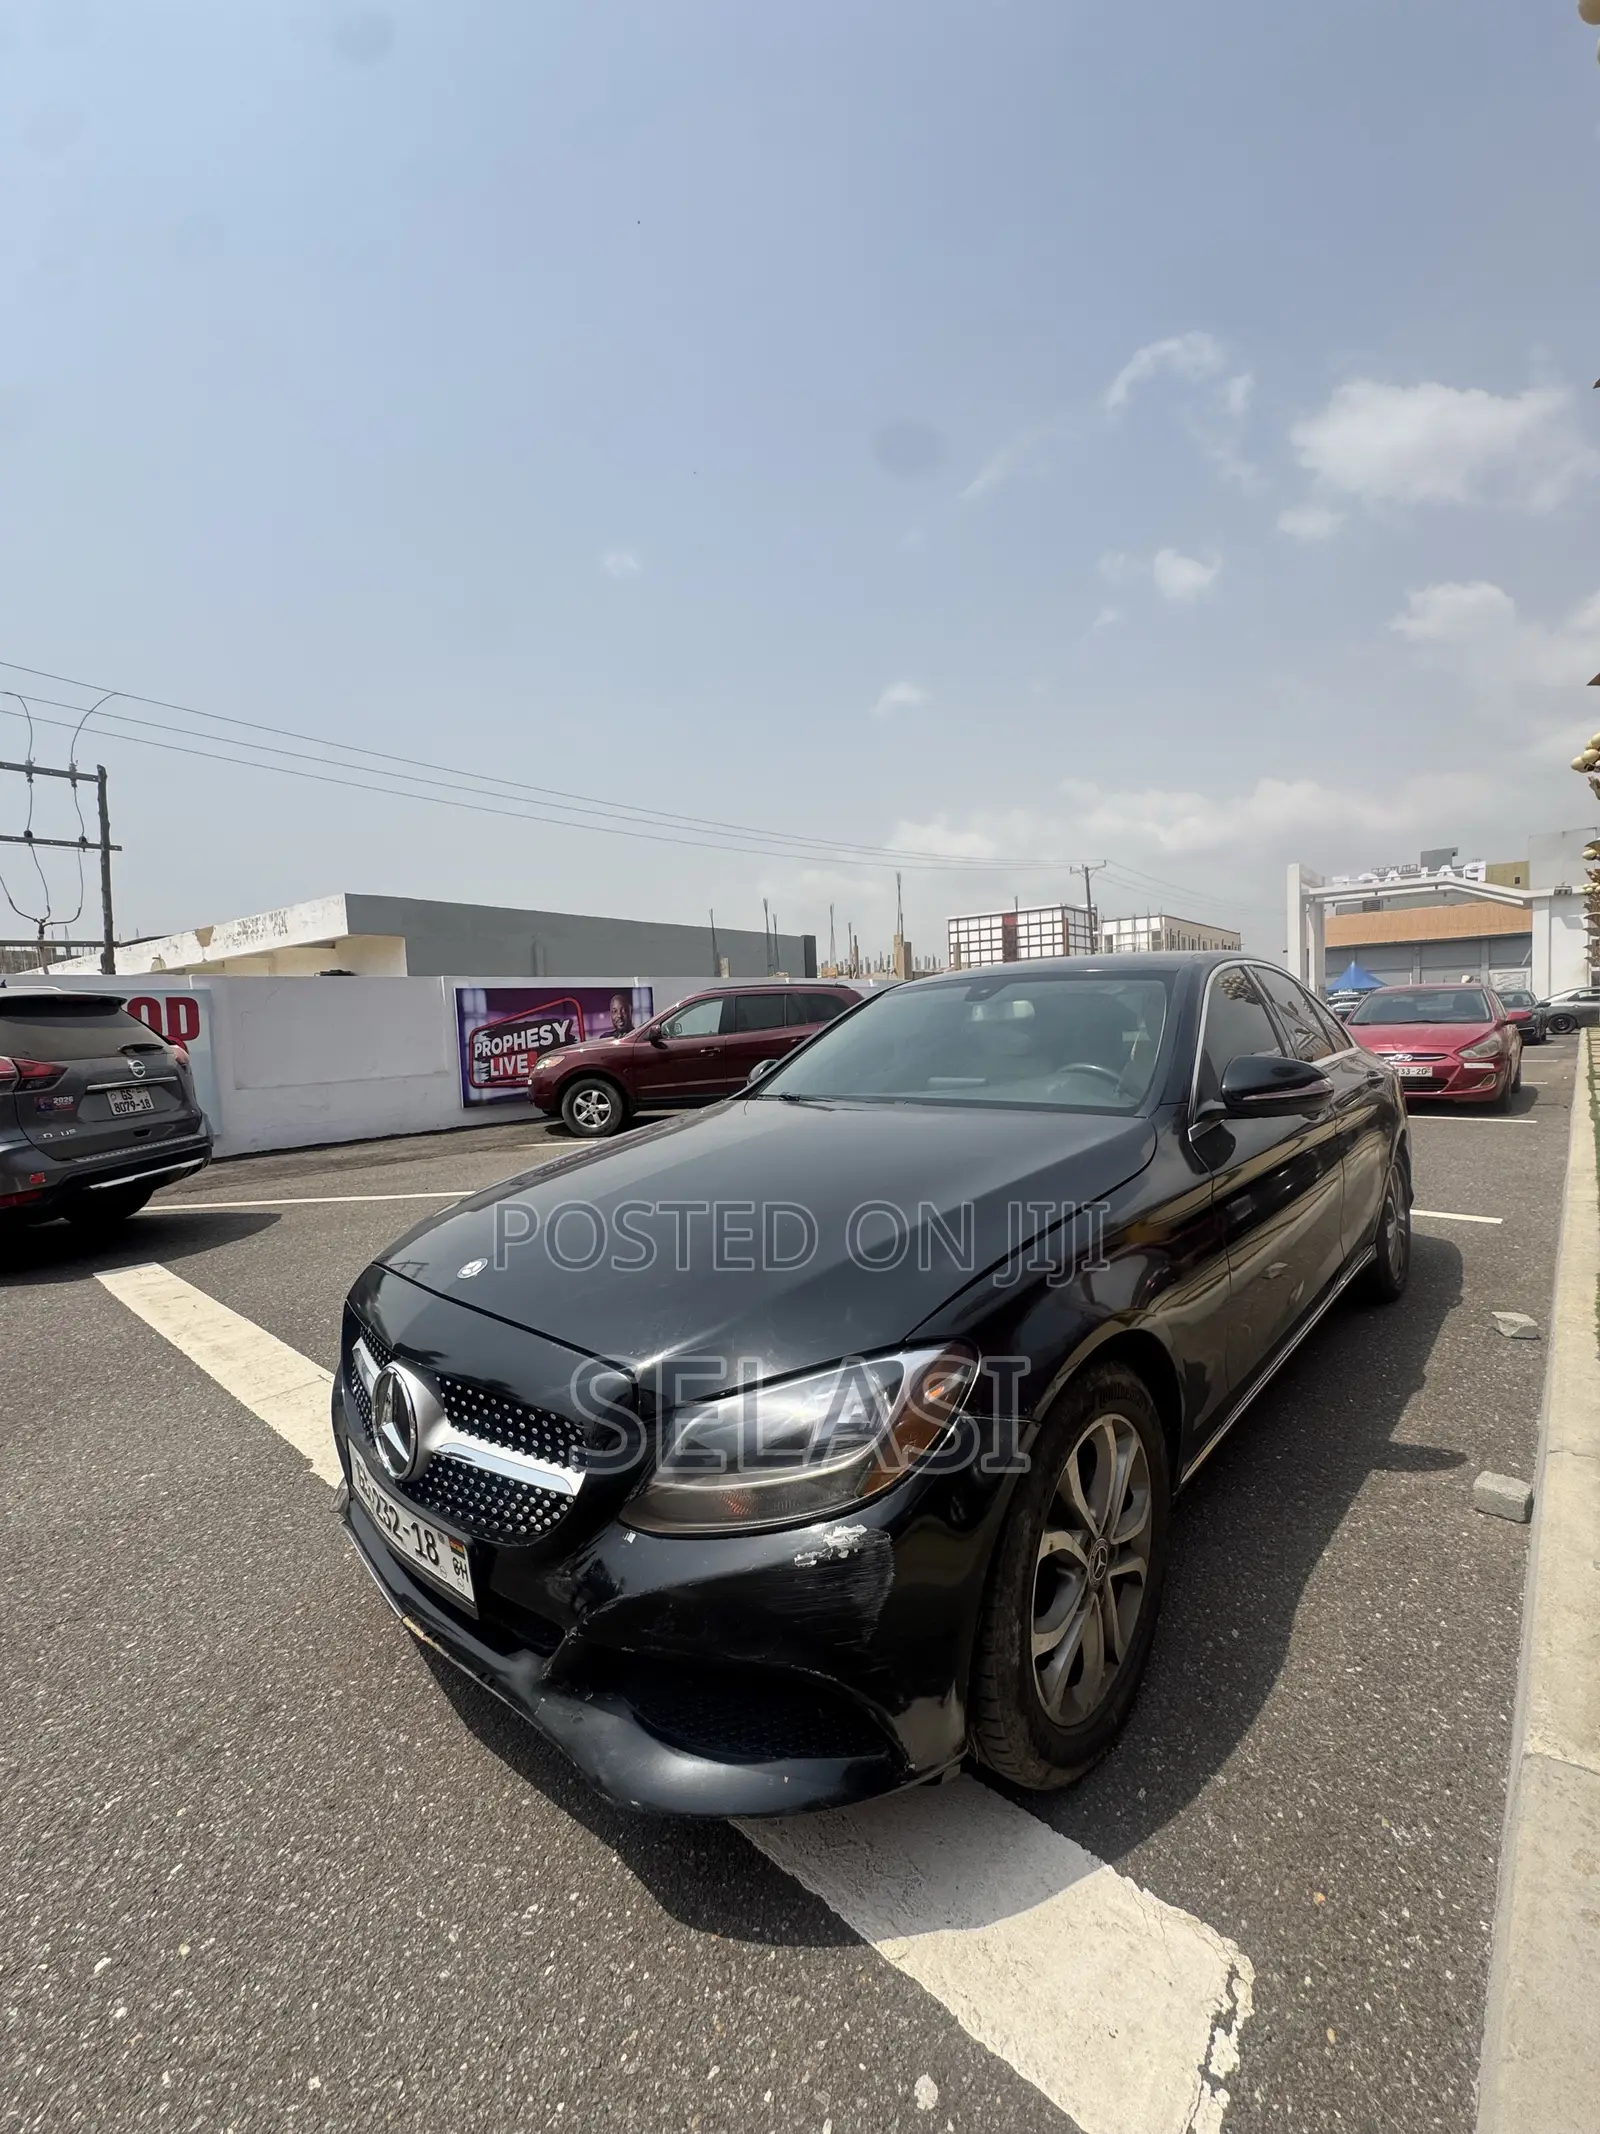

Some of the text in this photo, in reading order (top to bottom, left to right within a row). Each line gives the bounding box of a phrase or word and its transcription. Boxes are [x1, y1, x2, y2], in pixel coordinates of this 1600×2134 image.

[474, 1019, 571, 1059] PROPHESY
[490, 1053, 529, 1076] LIVE
[121, 1089, 133, 1100] GS
[114, 1098, 151, 1114] 8079-18
